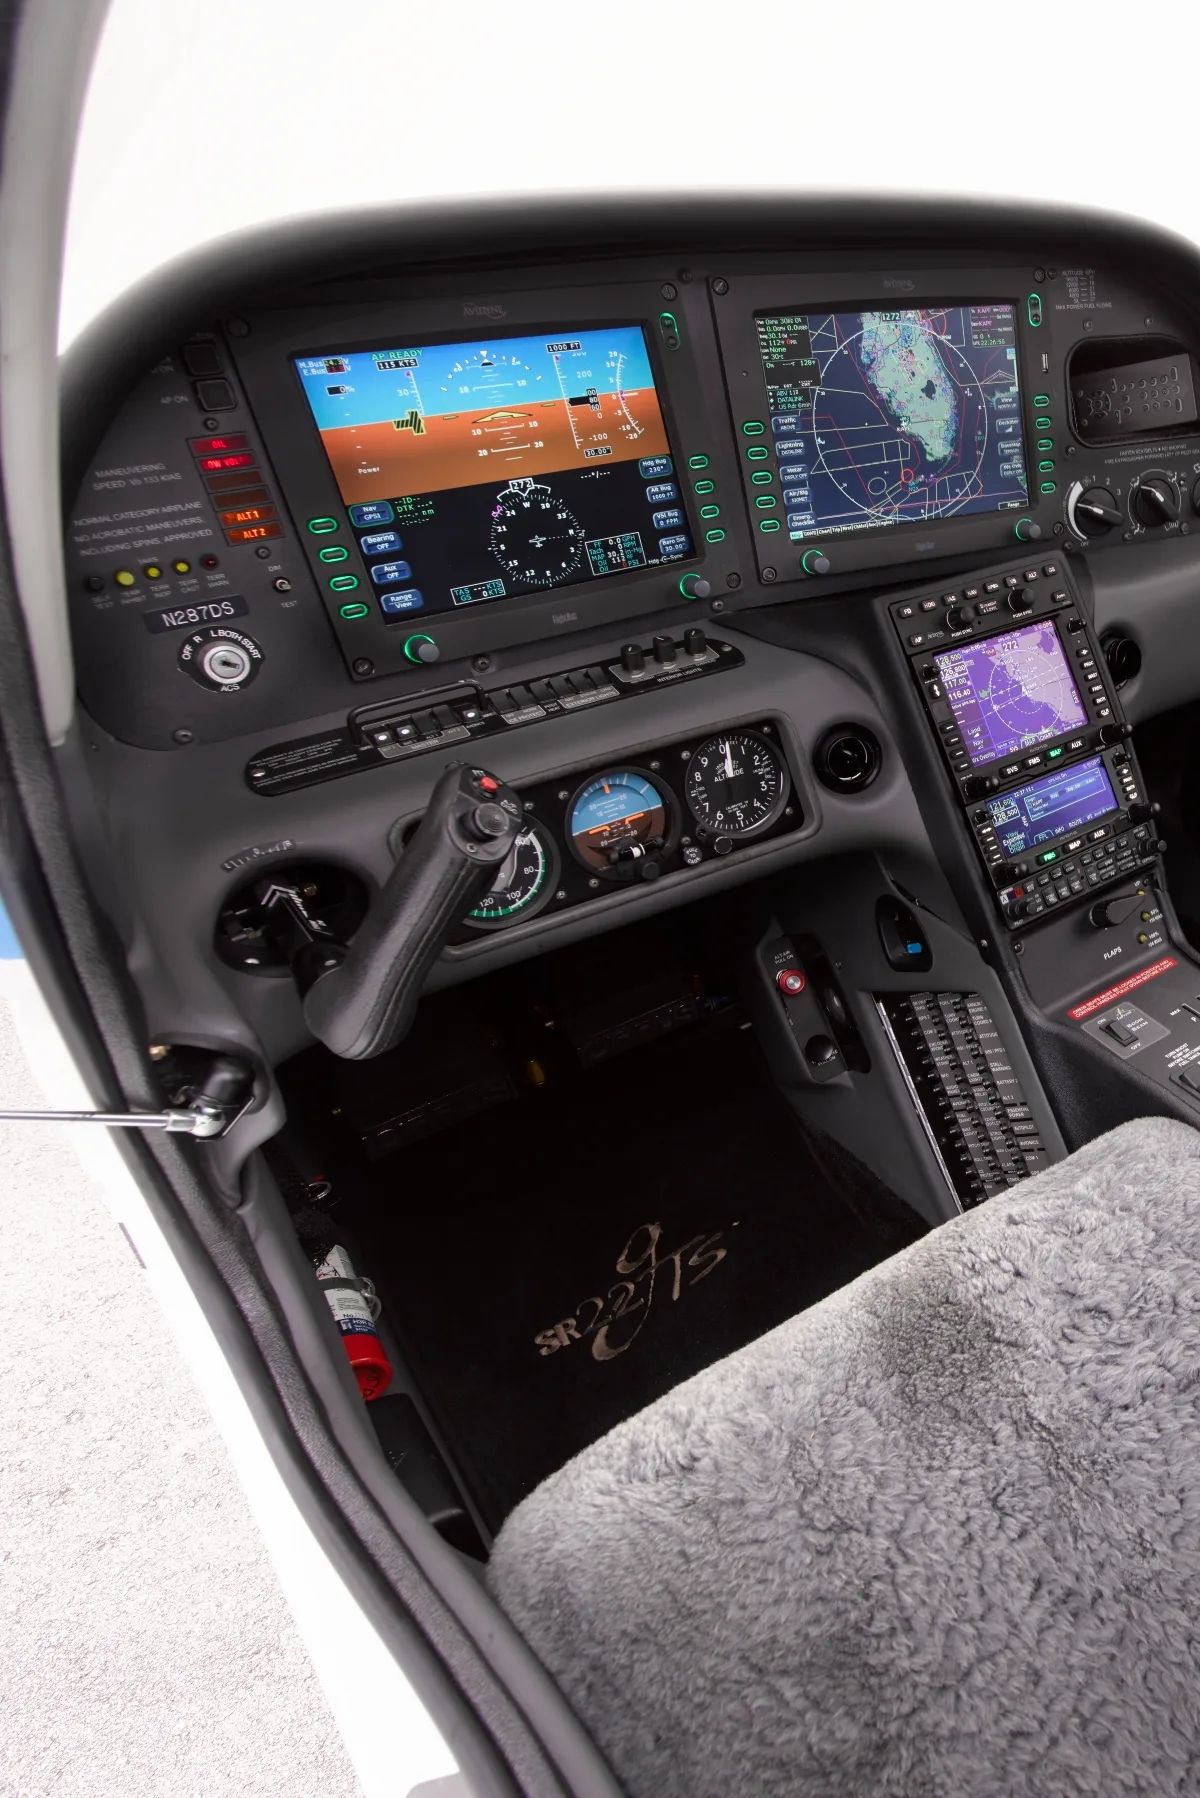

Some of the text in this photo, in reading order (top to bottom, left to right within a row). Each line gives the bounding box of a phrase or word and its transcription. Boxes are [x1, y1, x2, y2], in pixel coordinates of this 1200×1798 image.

[547, 342, 579, 352] 1000 FT
[371, 349, 424, 361] AP READY
[378, 359, 416, 370] 115 KTS
[576, 370, 592, 378] 200
[397, 388, 410, 397] 30
[472, 428, 482, 436] 10
[589, 433, 608, 441] -100
[211, 440, 227, 449] OIL
[778, 441, 804, 449] Lightning
[478, 449, 488, 457] 20
[642, 458, 667, 467] Hdg Bug
[95, 463, 166, 478] MANEUVERING
[358, 466, 380, 474] Power
[92, 480, 126, 491] SPEED
[143, 476, 159, 484] 133
[160, 472, 182, 481] KIAS
[513, 479, 532, 490] 272
[1116, 488, 1122, 496] 3
[397, 504, 414, 513] DTK
[505, 509, 516, 517] 24
[73, 501, 203, 527] NORMAL CATEGORY AIRPLANE
[236, 510, 259, 522] ALT 1
[363, 512, 382, 521] GPS1
[791, 519, 815, 527] Checklist
[74, 534, 90, 542] NO
[91, 525, 145, 541] ACROBATIC
[243, 528, 266, 539] ALT 2
[79, 543, 131, 556] INCLUDING
[164, 528, 213, 542] APPROVED
[367, 534, 395, 544] Bearing
[268, 564, 282, 572] DIM
[206, 573, 226, 582] TERR
[386, 572, 399, 580] OFF
[178, 577, 198, 587] TERR
[207, 579, 230, 589] WARN
[149, 583, 170, 593] TERR
[453, 582, 502, 596] TAS KTS
[390, 593, 413, 603] Range
[280, 600, 298, 609] TEST
[395, 600, 413, 609] View
[161, 601, 235, 627] N287DS
[192, 635, 203, 643] R
[210, 629, 262, 660] L BOTH START
[1002, 640, 1018, 652] 272
[182, 644, 193, 660] OFF
[220, 683, 240, 692] ACS
[944, 677, 967, 689] 117.00
[566, 690, 617, 708] EXTERIOR LIGHTS
[948, 689, 971, 701] 116.40
[518, 711, 545, 721] PROTECT
[967, 726, 981, 736] Land
[411, 739, 439, 750] MASTER
[718, 744, 726, 754] 0
[1071, 740, 1083, 749] AUX
[741, 745, 745, 755] 1
[1049, 748, 1062, 758] MAP
[700, 757, 708, 767] 9
[754, 755, 760, 765] 2
[1028, 756, 1041, 766] FMS
[1006, 765, 1019, 775] SVS
[694, 771, 701, 782] 8
[760, 780, 767, 791] 3
[703, 802, 709, 813] 7
[753, 798, 761, 807] 4
[716, 810, 724, 821] 6
[736, 810, 744, 820] 5
[1093, 829, 1105, 839] AUX
[1069, 840, 1081, 850] MAP
[1043, 852, 1056, 862] FMS
[523, 865, 535, 875] 80
[506, 890, 521, 901] 100
[480, 897, 494, 908] 120
[1103, 946, 1122, 960] FLAPS
[1169, 1008, 1181, 1016] MAX
[1126, 1017, 1144, 1029] BOOM
[1131, 1021, 1149, 1032] BEAM
[1130, 1043, 1141, 1051] OFF
[1165, 1043, 1189, 1058] TURN BOOST
[1168, 1058, 1184, 1069] BEFORE
